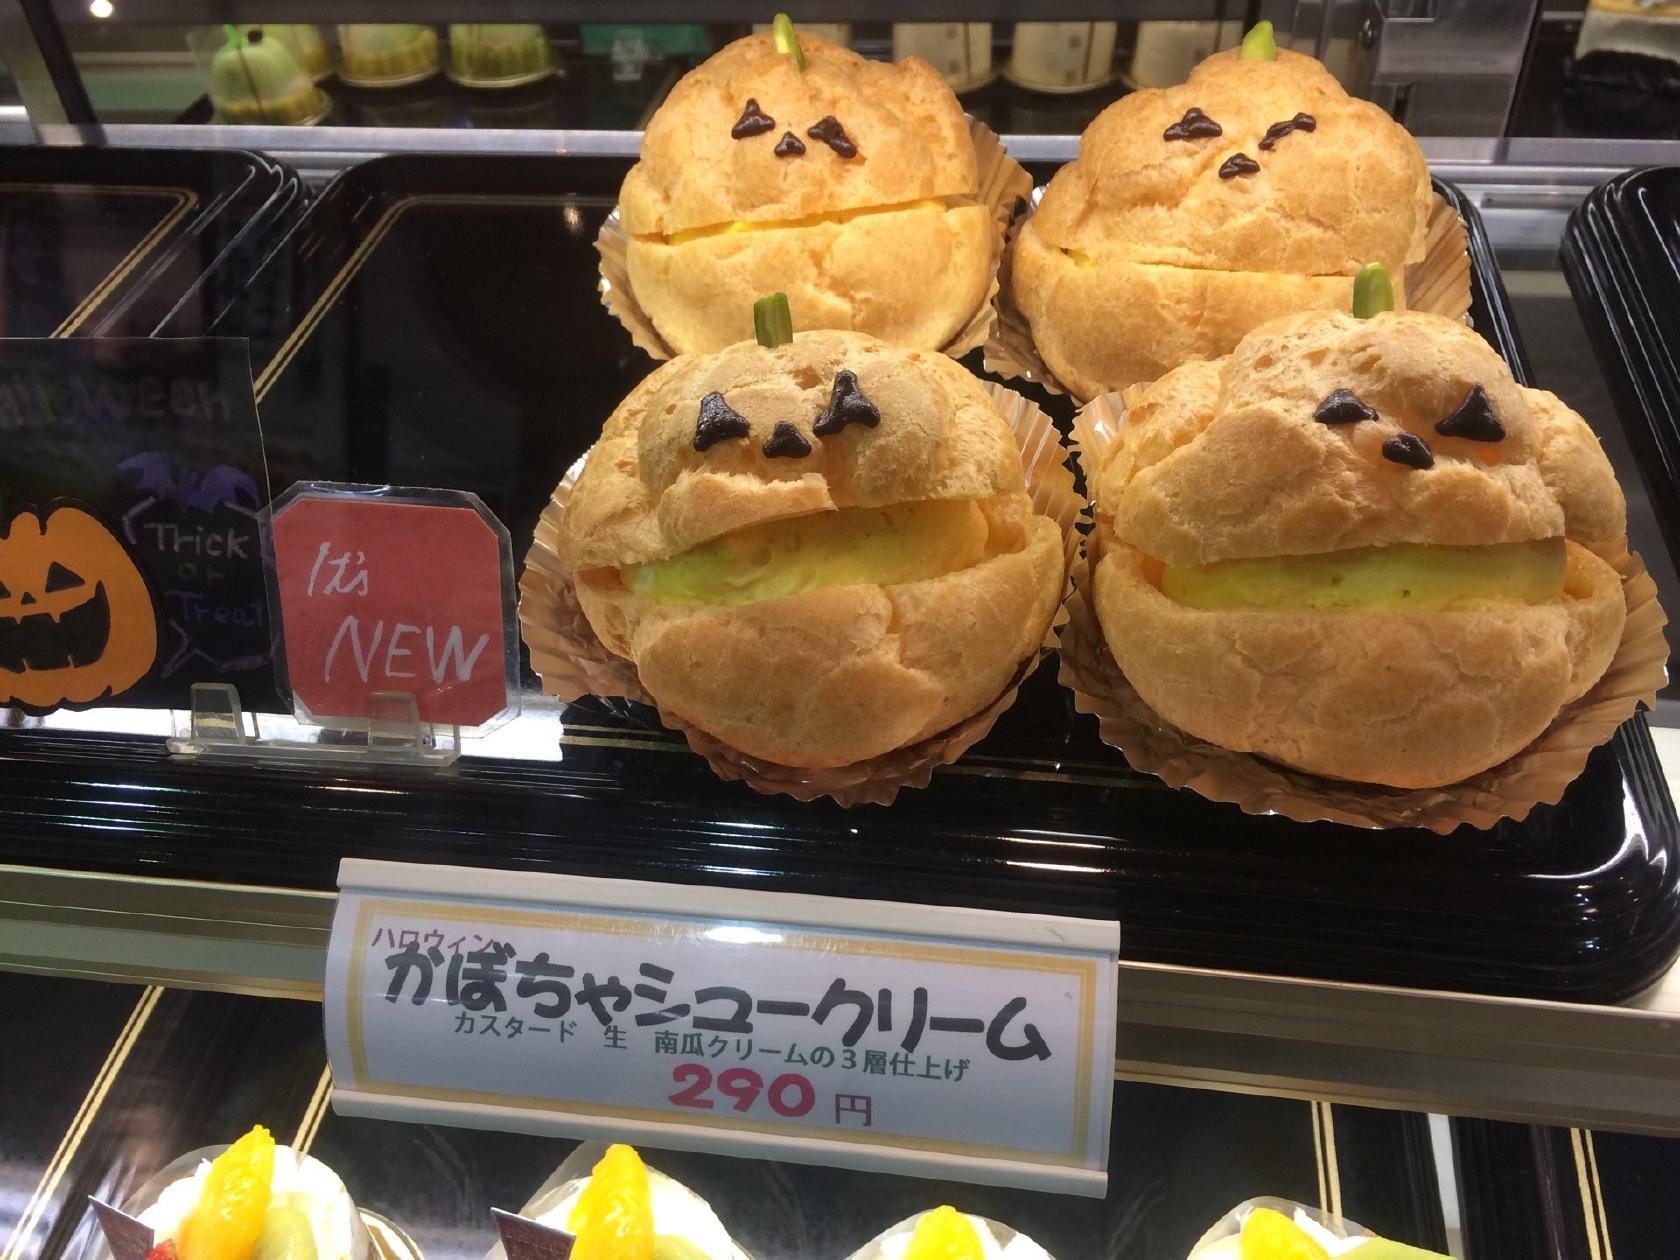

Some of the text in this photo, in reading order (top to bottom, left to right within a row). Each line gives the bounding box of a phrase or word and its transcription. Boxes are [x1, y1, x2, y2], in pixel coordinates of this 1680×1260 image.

[143, 522, 250, 560] Trick
[178, 562, 225, 586] or
[307, 541, 370, 597] It's
[163, 590, 267, 629] Treat
[325, 615, 490, 684] NEW
[384, 940, 1053, 1062] かぼちゃシュークリーム
[454, 1011, 578, 1044] カスタード
[603, 1024, 628, 1050] 生
[668, 1062, 872, 1128] 290 円
